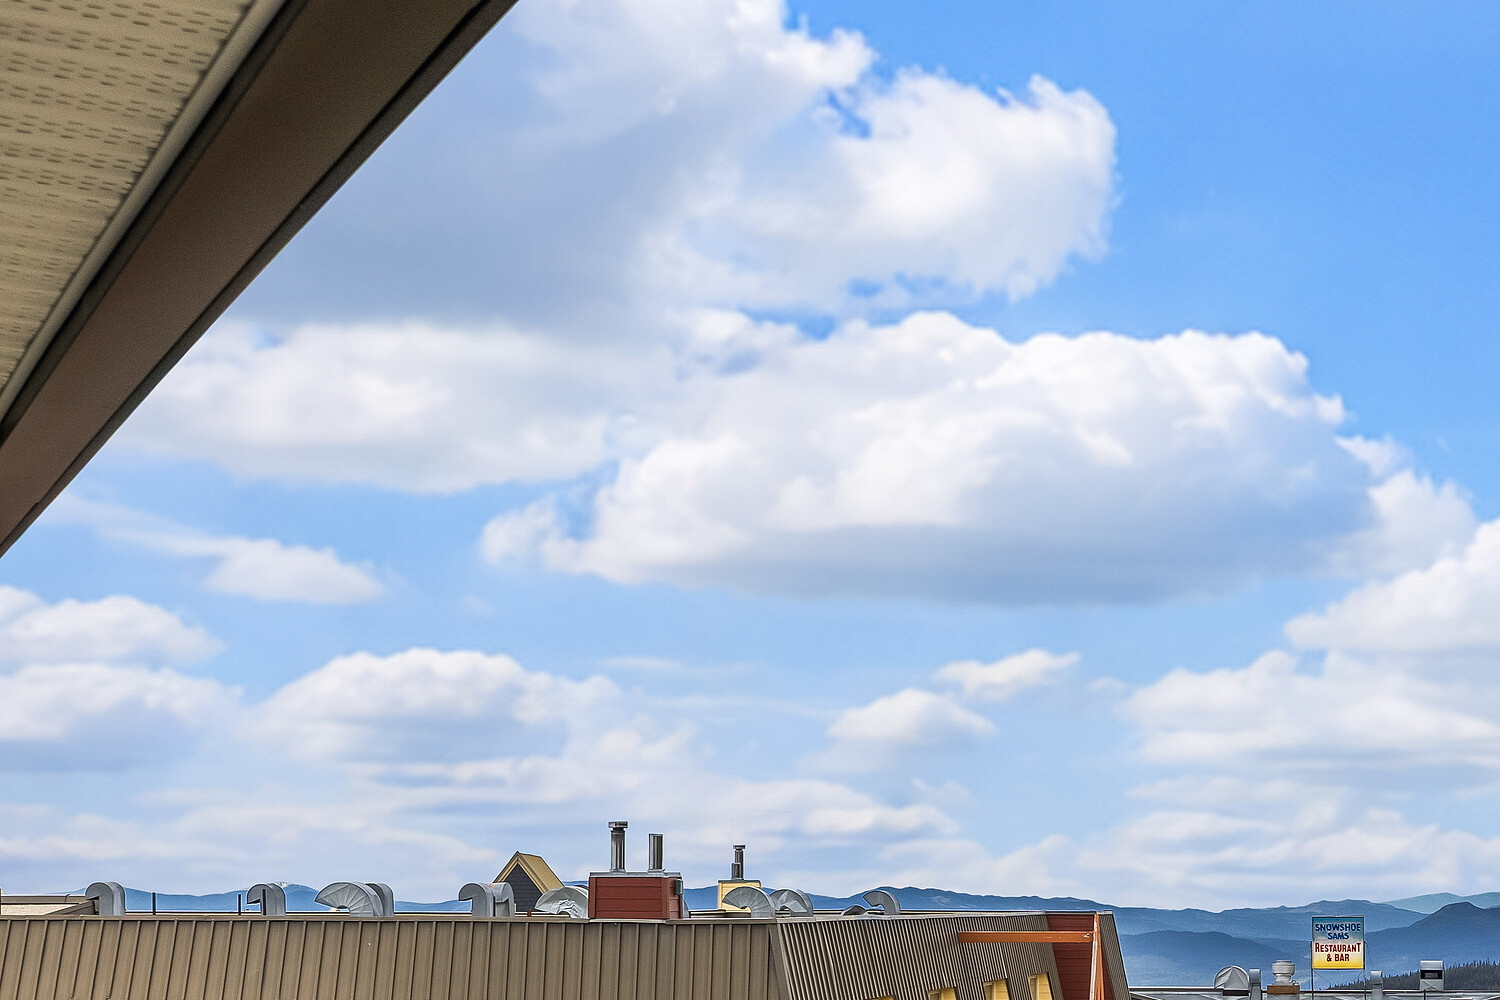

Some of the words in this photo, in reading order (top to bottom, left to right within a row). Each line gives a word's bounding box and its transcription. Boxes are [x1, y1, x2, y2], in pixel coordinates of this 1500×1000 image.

[1315, 923, 1361, 931] SNOWSHOE
[1327, 932, 1349, 940] SAMS
[1326, 953, 1332, 962] &
[1334, 953, 1350, 962] BAR
